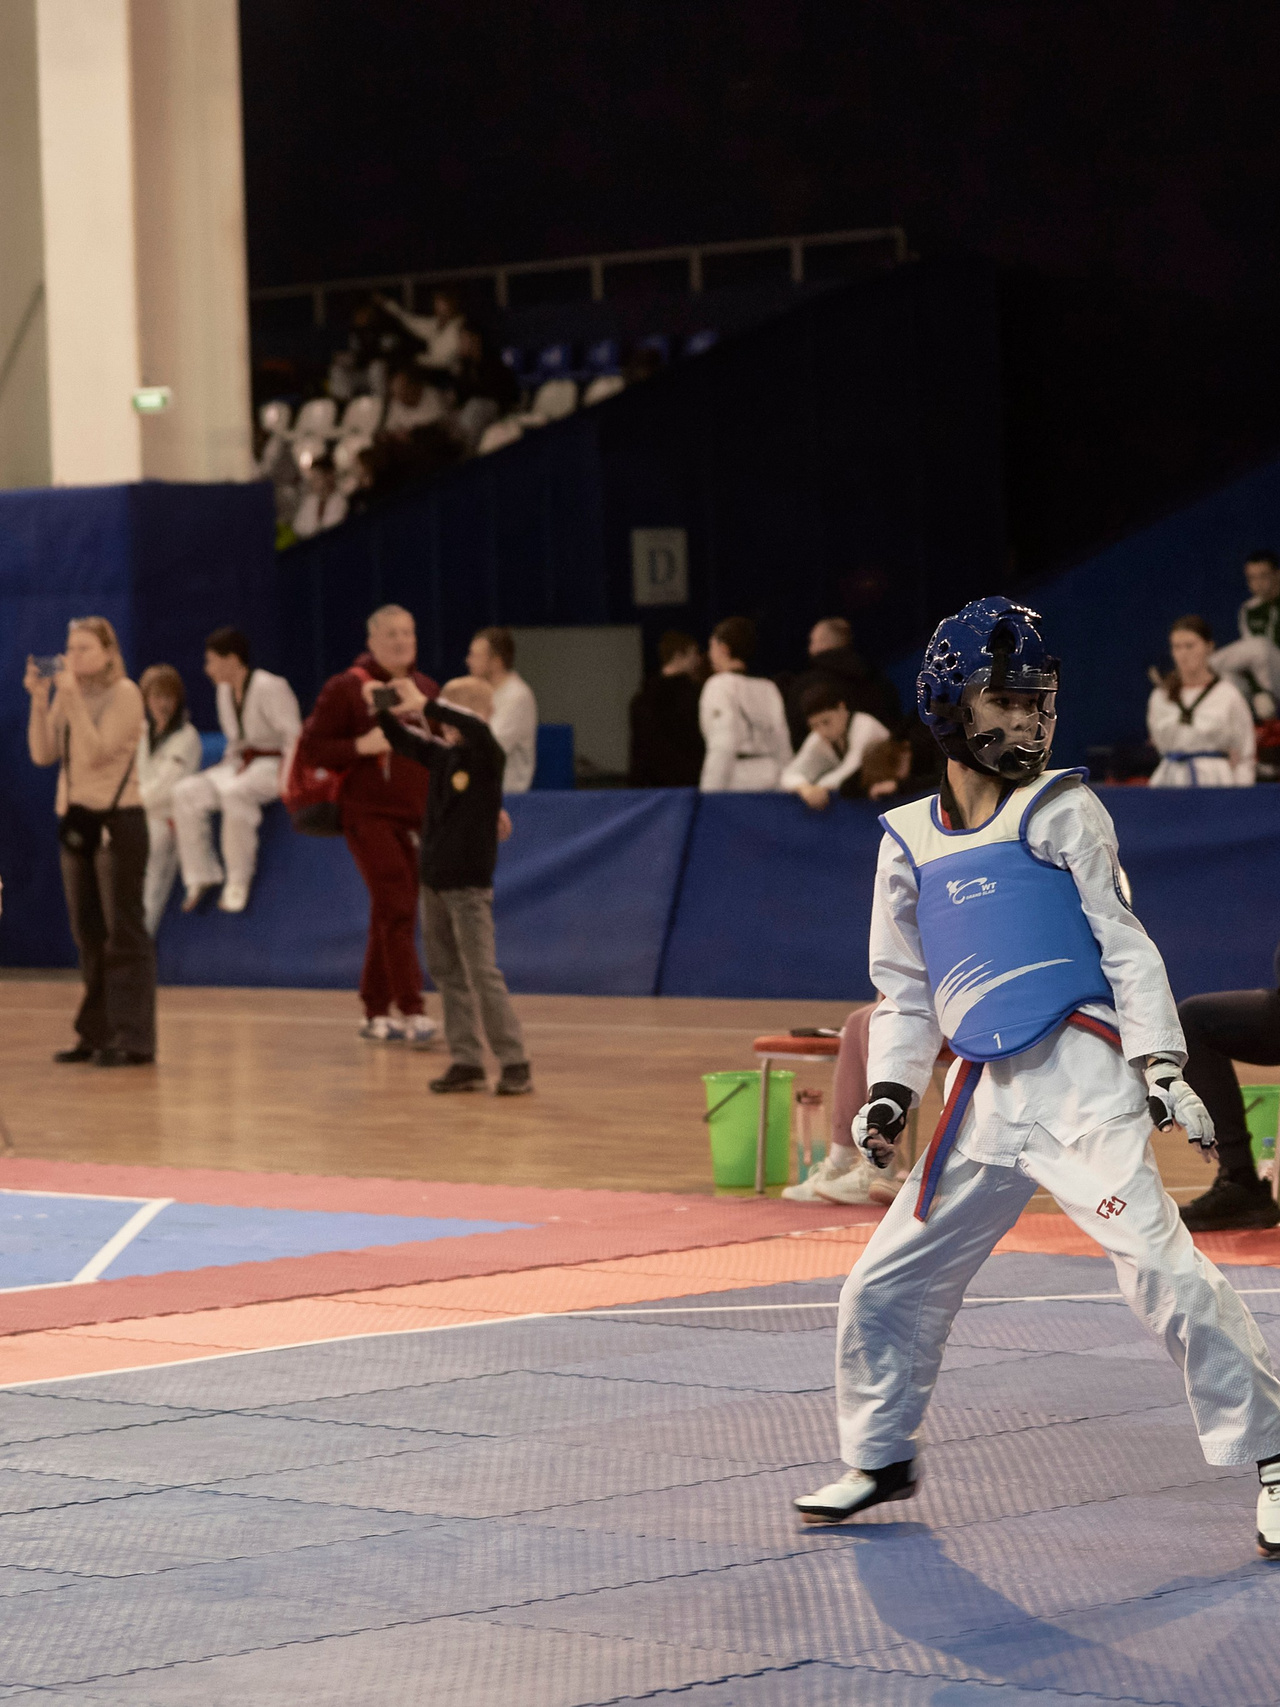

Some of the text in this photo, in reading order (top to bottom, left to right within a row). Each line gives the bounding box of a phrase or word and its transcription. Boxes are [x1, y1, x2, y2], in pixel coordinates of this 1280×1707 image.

[648, 547, 676, 585] D
[981, 881, 997, 891] WT
[992, 1033, 1002, 1049] 1
